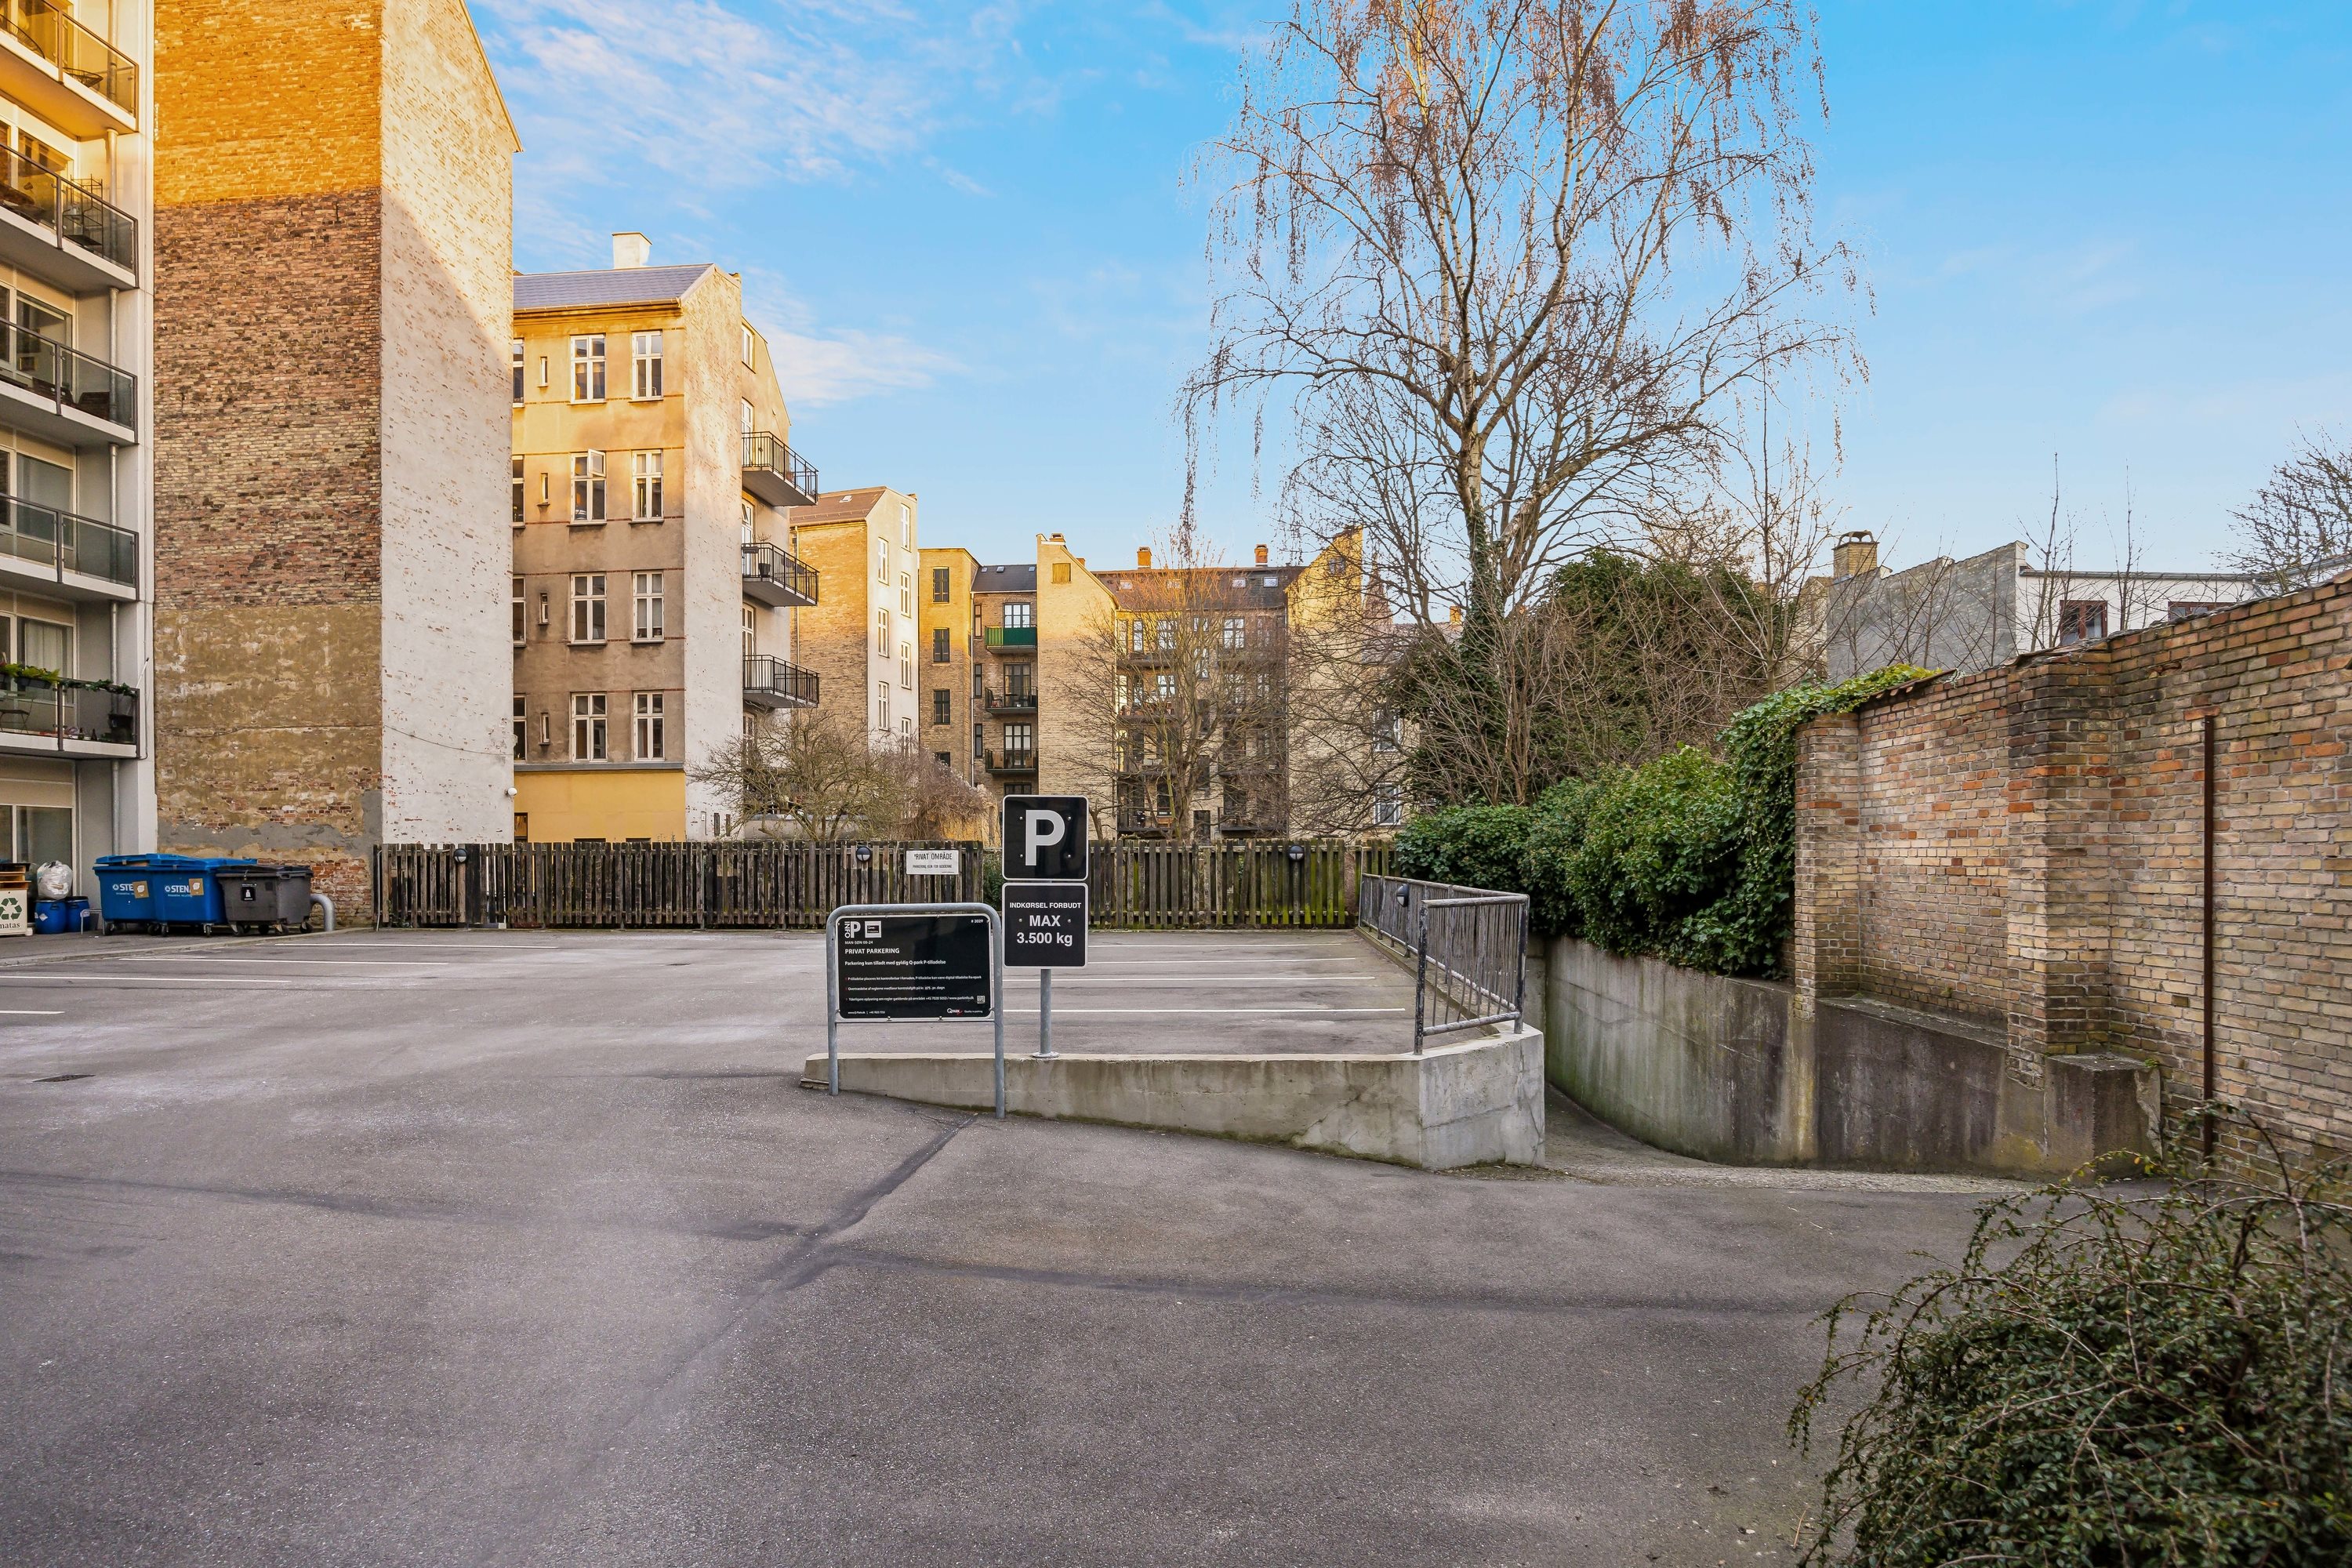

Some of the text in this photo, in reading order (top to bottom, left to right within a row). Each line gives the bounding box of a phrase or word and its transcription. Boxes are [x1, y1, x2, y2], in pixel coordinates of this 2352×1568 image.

[1025, 810, 1065, 866] P
[931, 851, 953, 860] OMRÅDE
[1029, 915, 1061, 927] MAX
[1016, 932, 1073, 947] 3.500 kg
